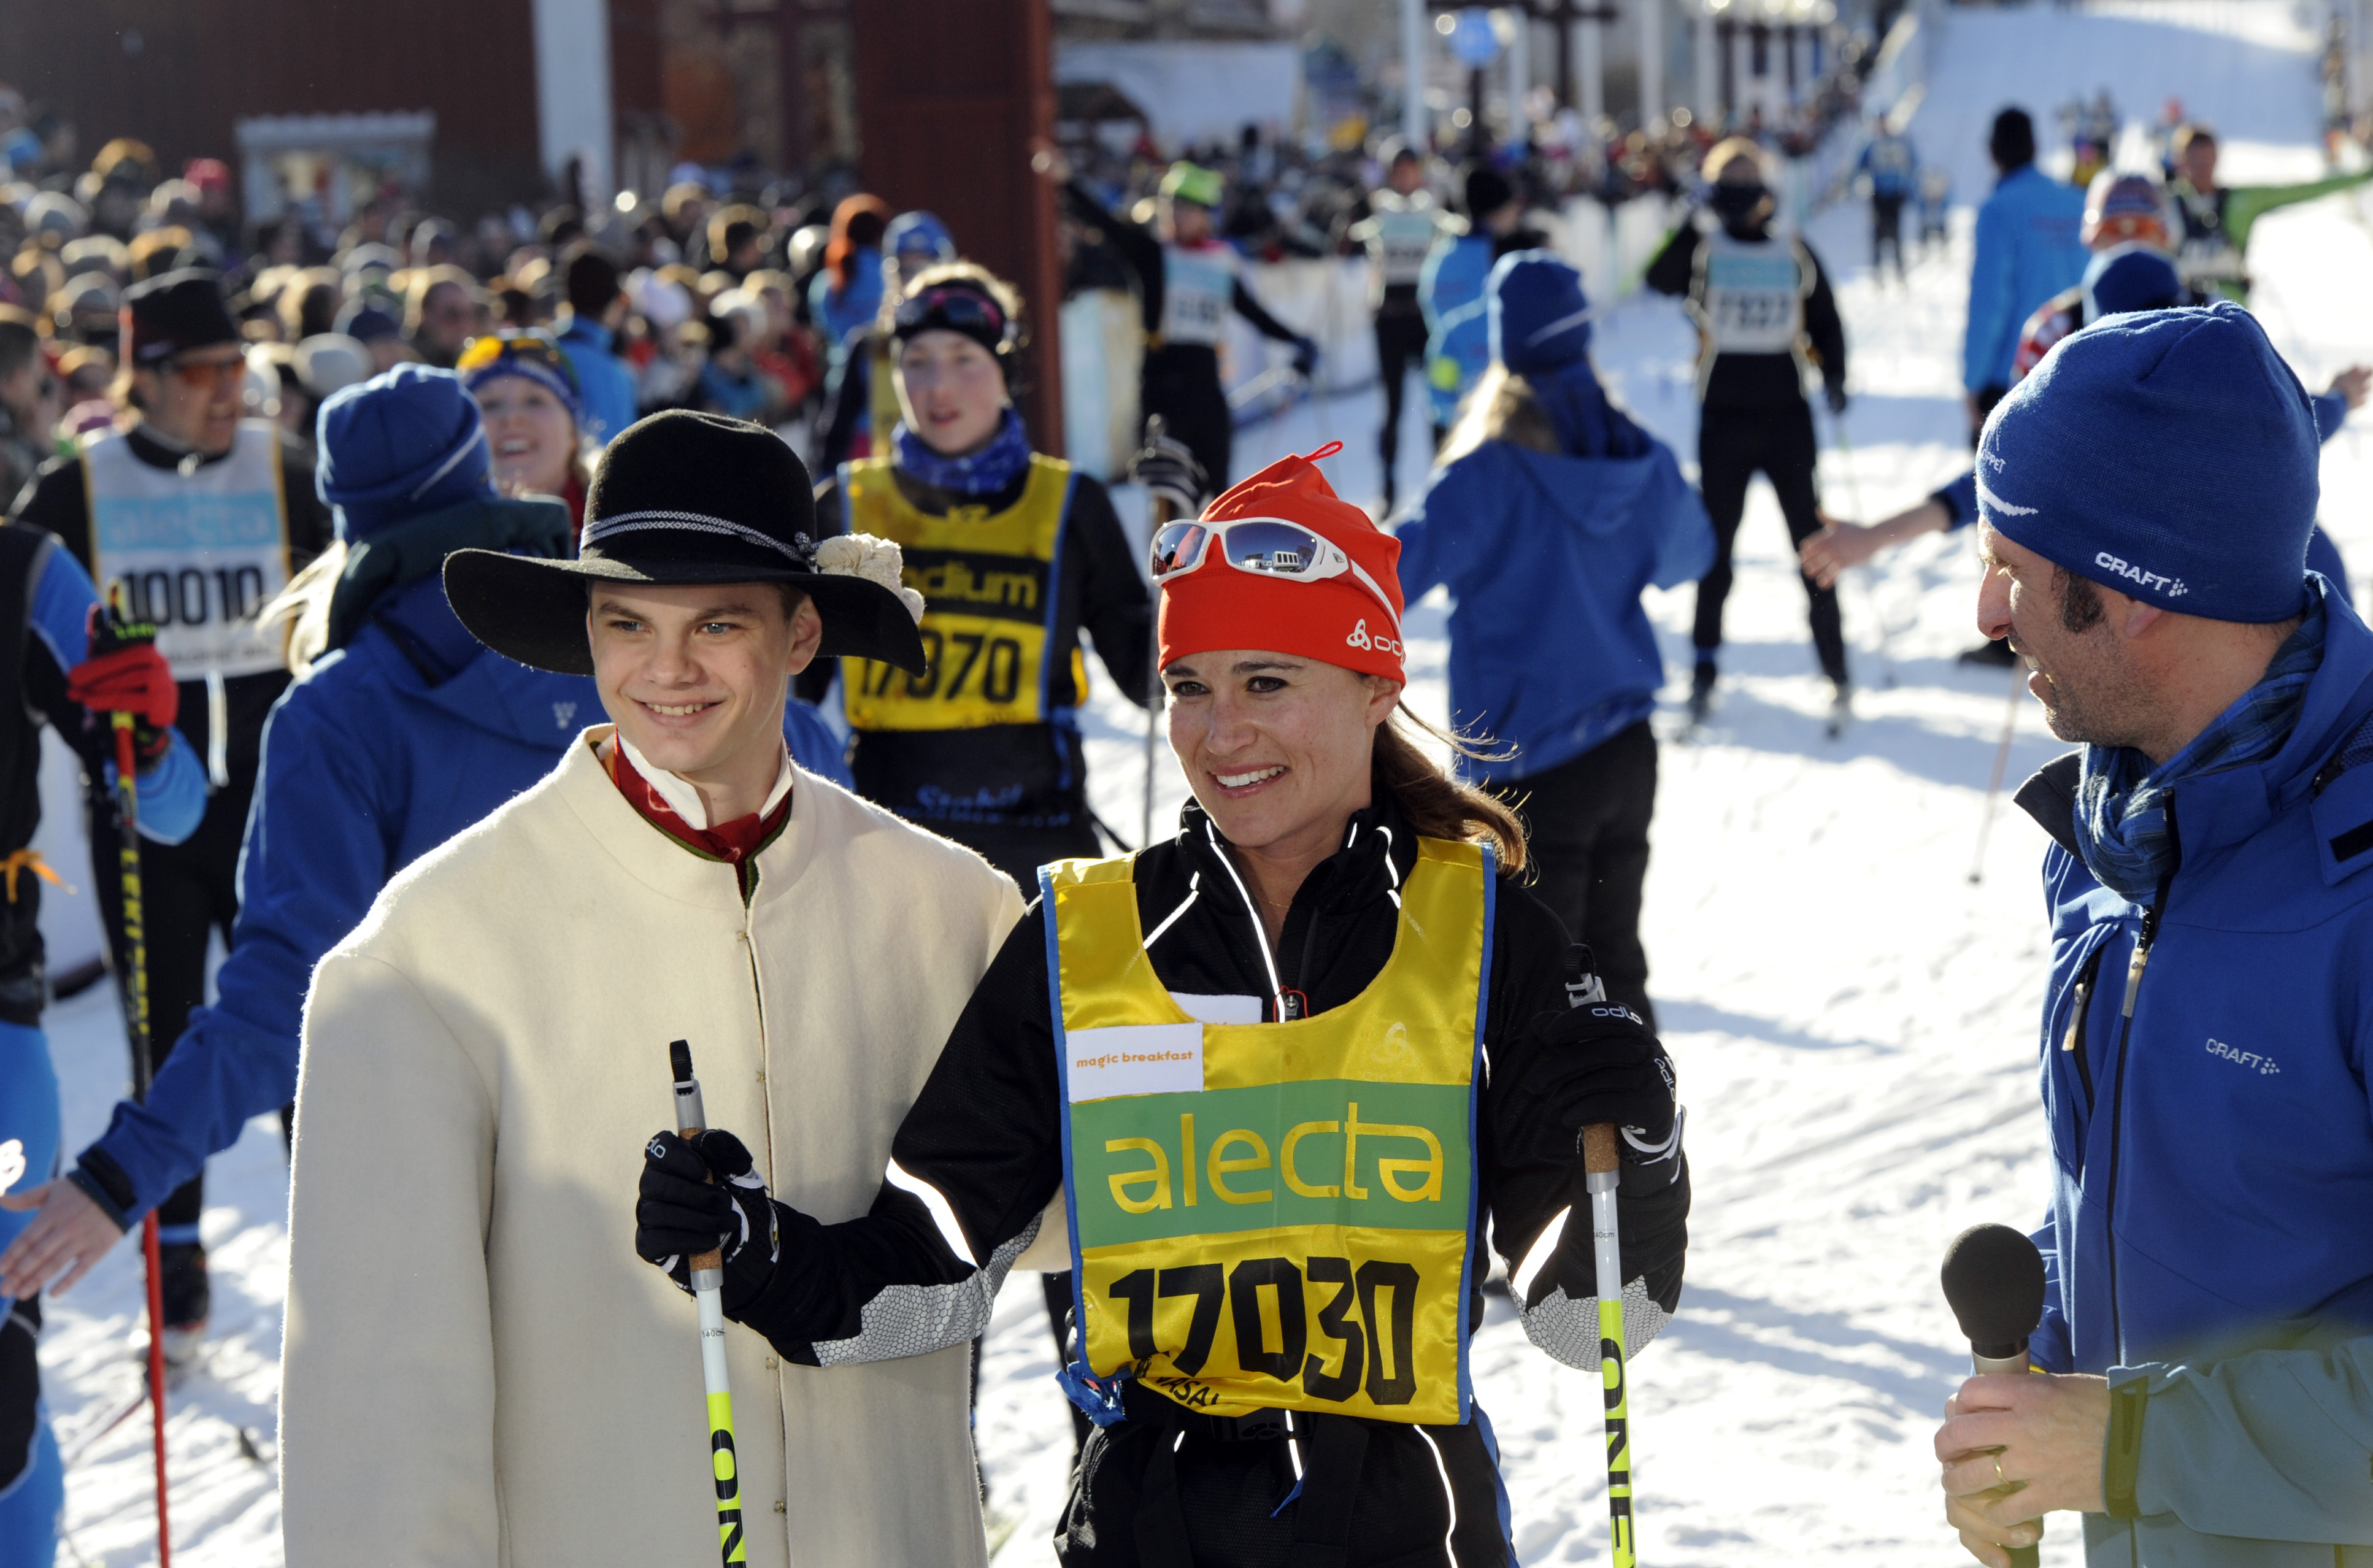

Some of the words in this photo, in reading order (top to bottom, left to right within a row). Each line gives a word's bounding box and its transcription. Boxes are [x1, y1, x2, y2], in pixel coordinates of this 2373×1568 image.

[1980, 448, 2006, 474] OPPET
[901, 559, 1037, 610] adium
[2095, 551, 2171, 591] CRAFT
[123, 565, 264, 627] 10010
[1591, 1006, 1644, 1025] odlo
[1077, 1055, 1118, 1068] magic
[1123, 1051, 1193, 1063] breakfast
[2206, 1038, 2263, 1069] CRAFT
[646, 1138, 666, 1159] dlo
[1106, 1102, 1443, 1213] alecta
[1109, 1257, 1420, 1405] 17030
